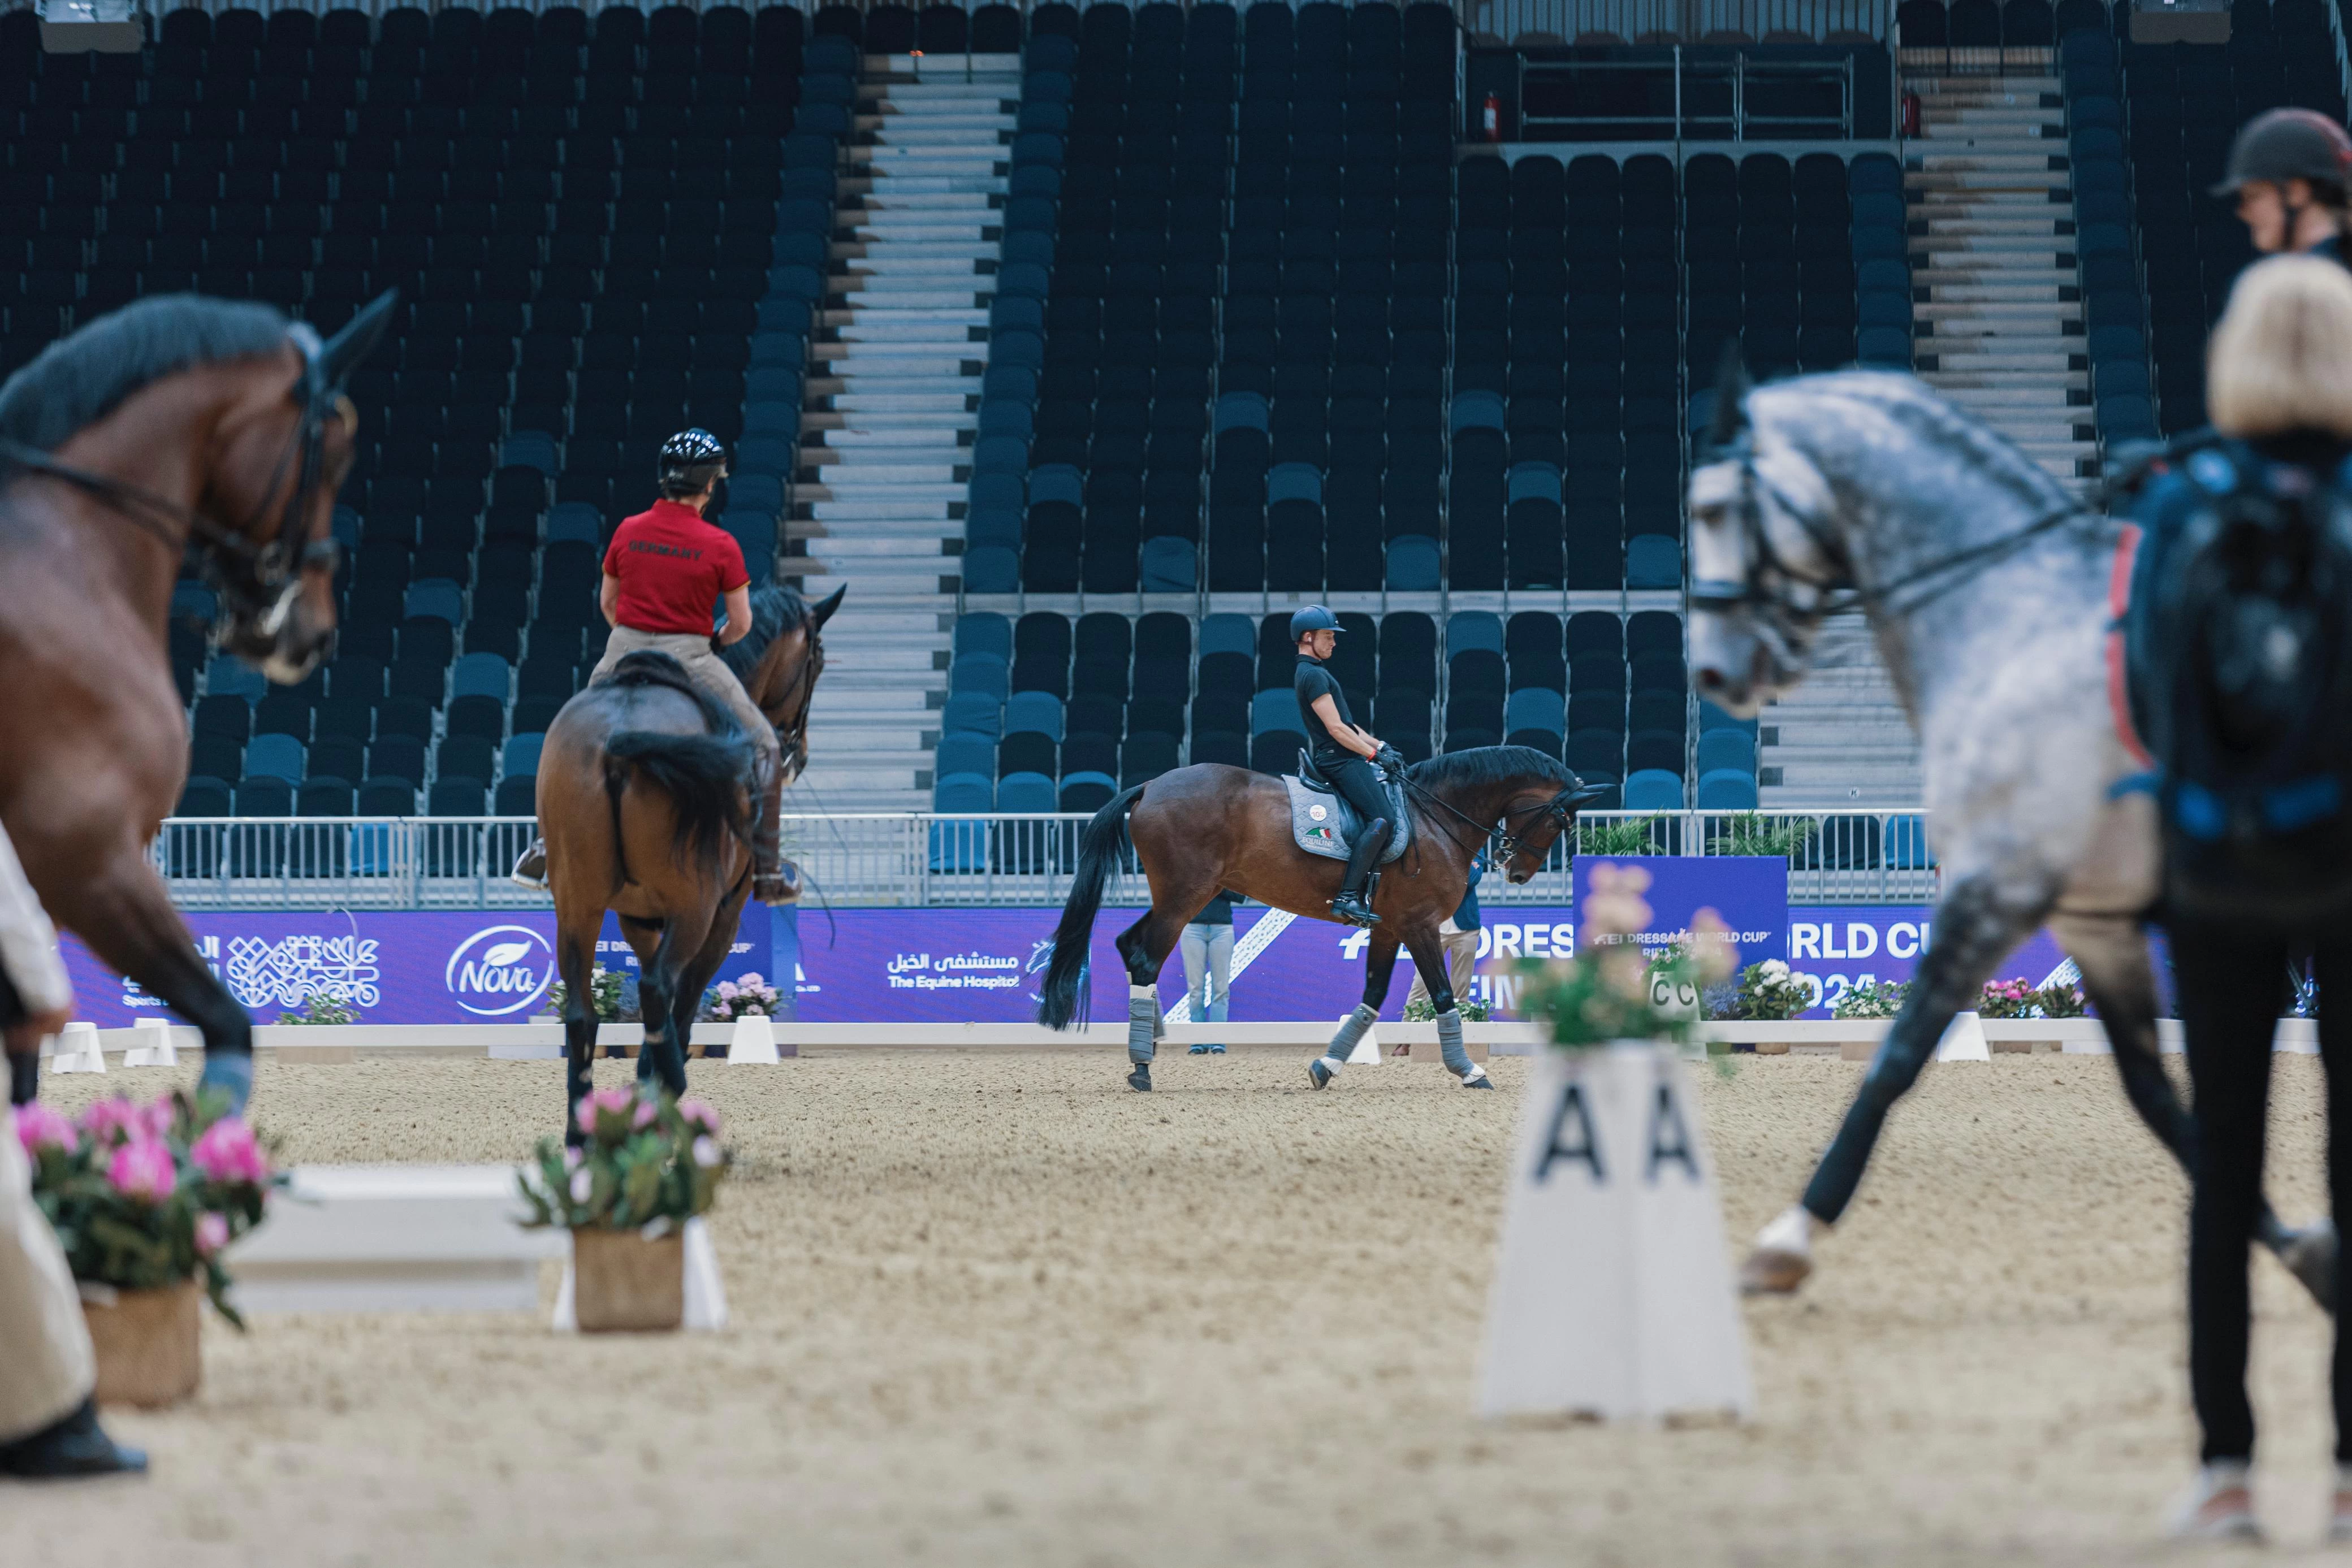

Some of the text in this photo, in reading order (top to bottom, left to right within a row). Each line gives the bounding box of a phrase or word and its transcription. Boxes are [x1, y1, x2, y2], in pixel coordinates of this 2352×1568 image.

[629, 539, 703, 561] GERMANY
[1302, 836, 1335, 847] EQUILINE
[1628, 933, 1693, 944] DRESSE
[1787, 922, 1878, 959] RLD
[887, 953, 930, 973] الخيل
[459, 960, 535, 993] Nova
[887, 975, 1020, 990] The Equine Hospital
[122, 994, 162, 1008] Sports
[1653, 980, 1670, 1007] C
[1677, 981, 1694, 1007] C
[1533, 1085, 1609, 1183] A
[1645, 1085, 1700, 1183] A
